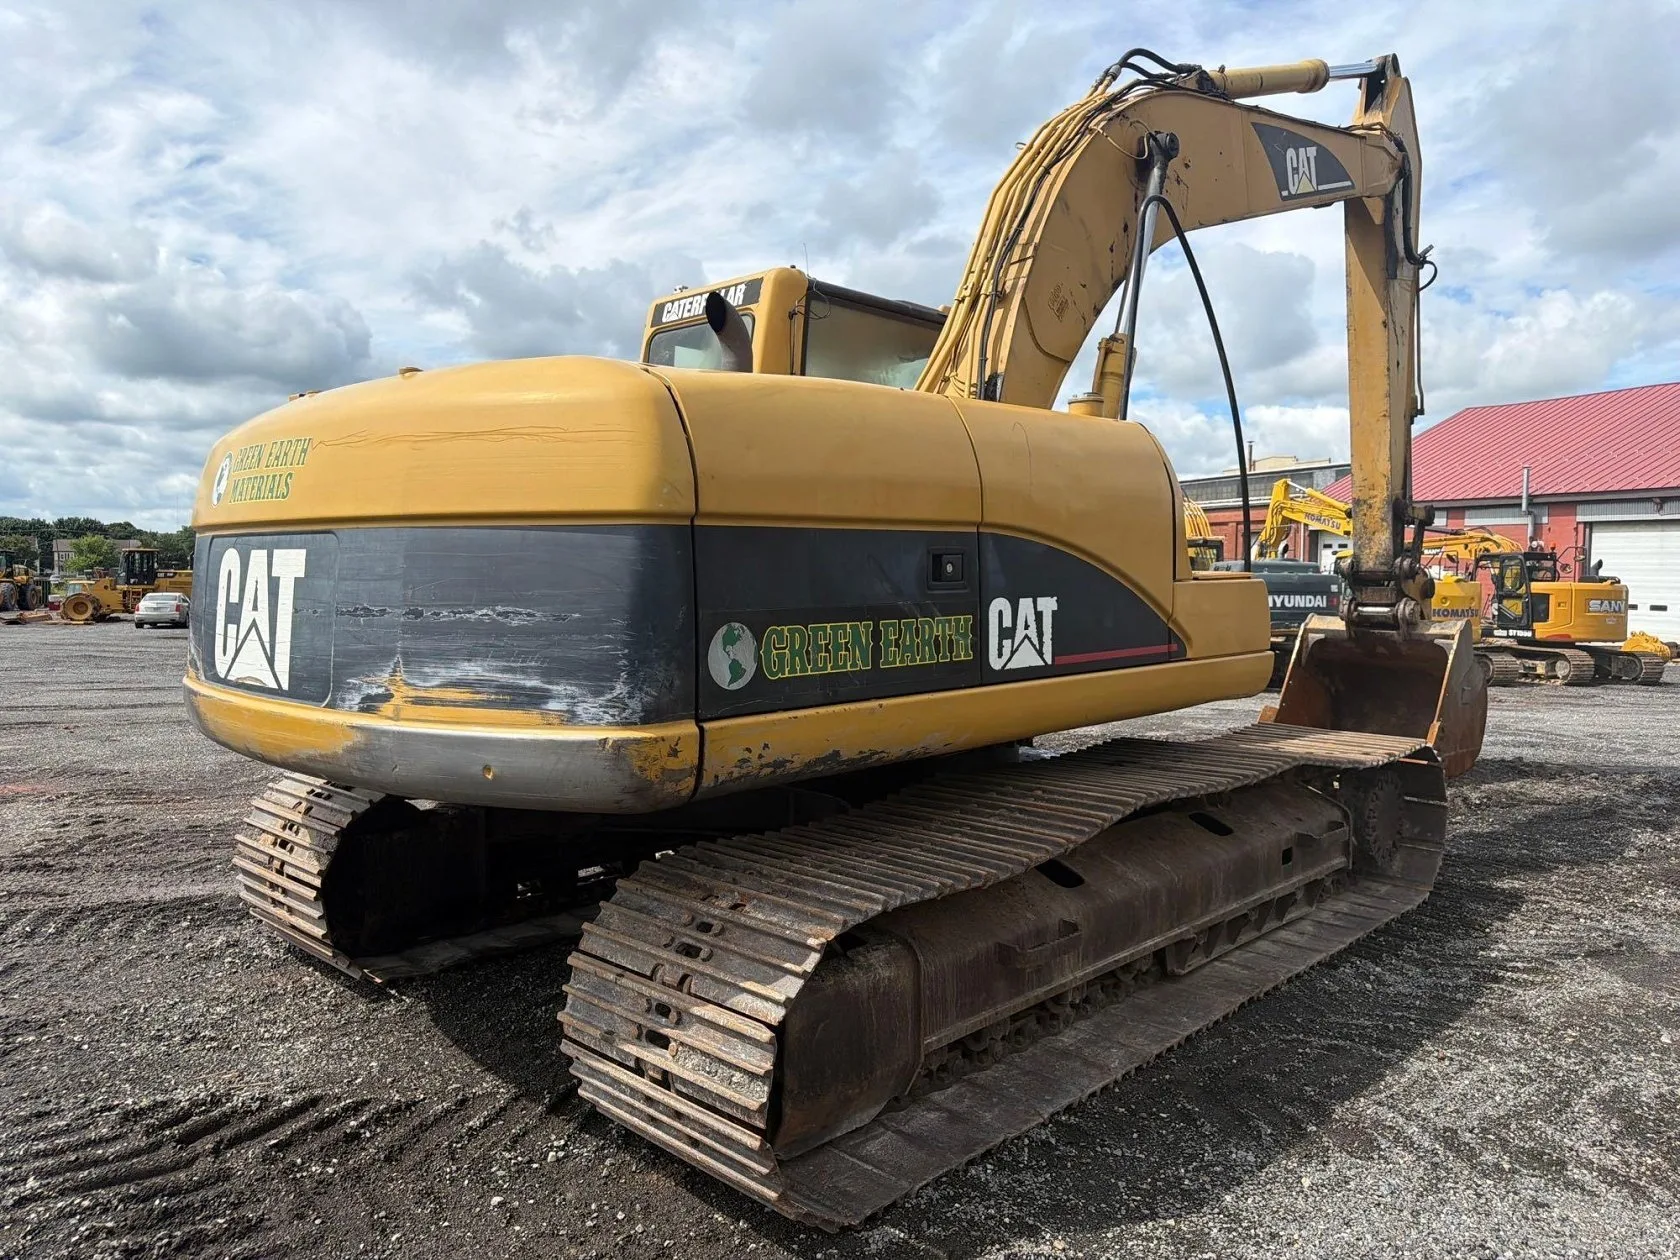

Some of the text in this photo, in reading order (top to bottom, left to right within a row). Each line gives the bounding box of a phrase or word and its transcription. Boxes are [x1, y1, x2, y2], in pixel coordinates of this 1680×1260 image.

[1286, 146, 1317, 195] CAT
[662, 283, 747, 323] CATERPAR
[232, 436, 313, 474] GREEN EARTH
[228, 472, 294, 504] MATERIALS
[1304, 512, 1341, 530] KOMATSU
[215, 547, 307, 691] CAT
[1432, 608, 1479, 618] KOMATSU
[1589, 599, 1626, 612] SANY
[760, 615, 974, 680] GREEN EARTH
[988, 596, 1058, 671] CAT
